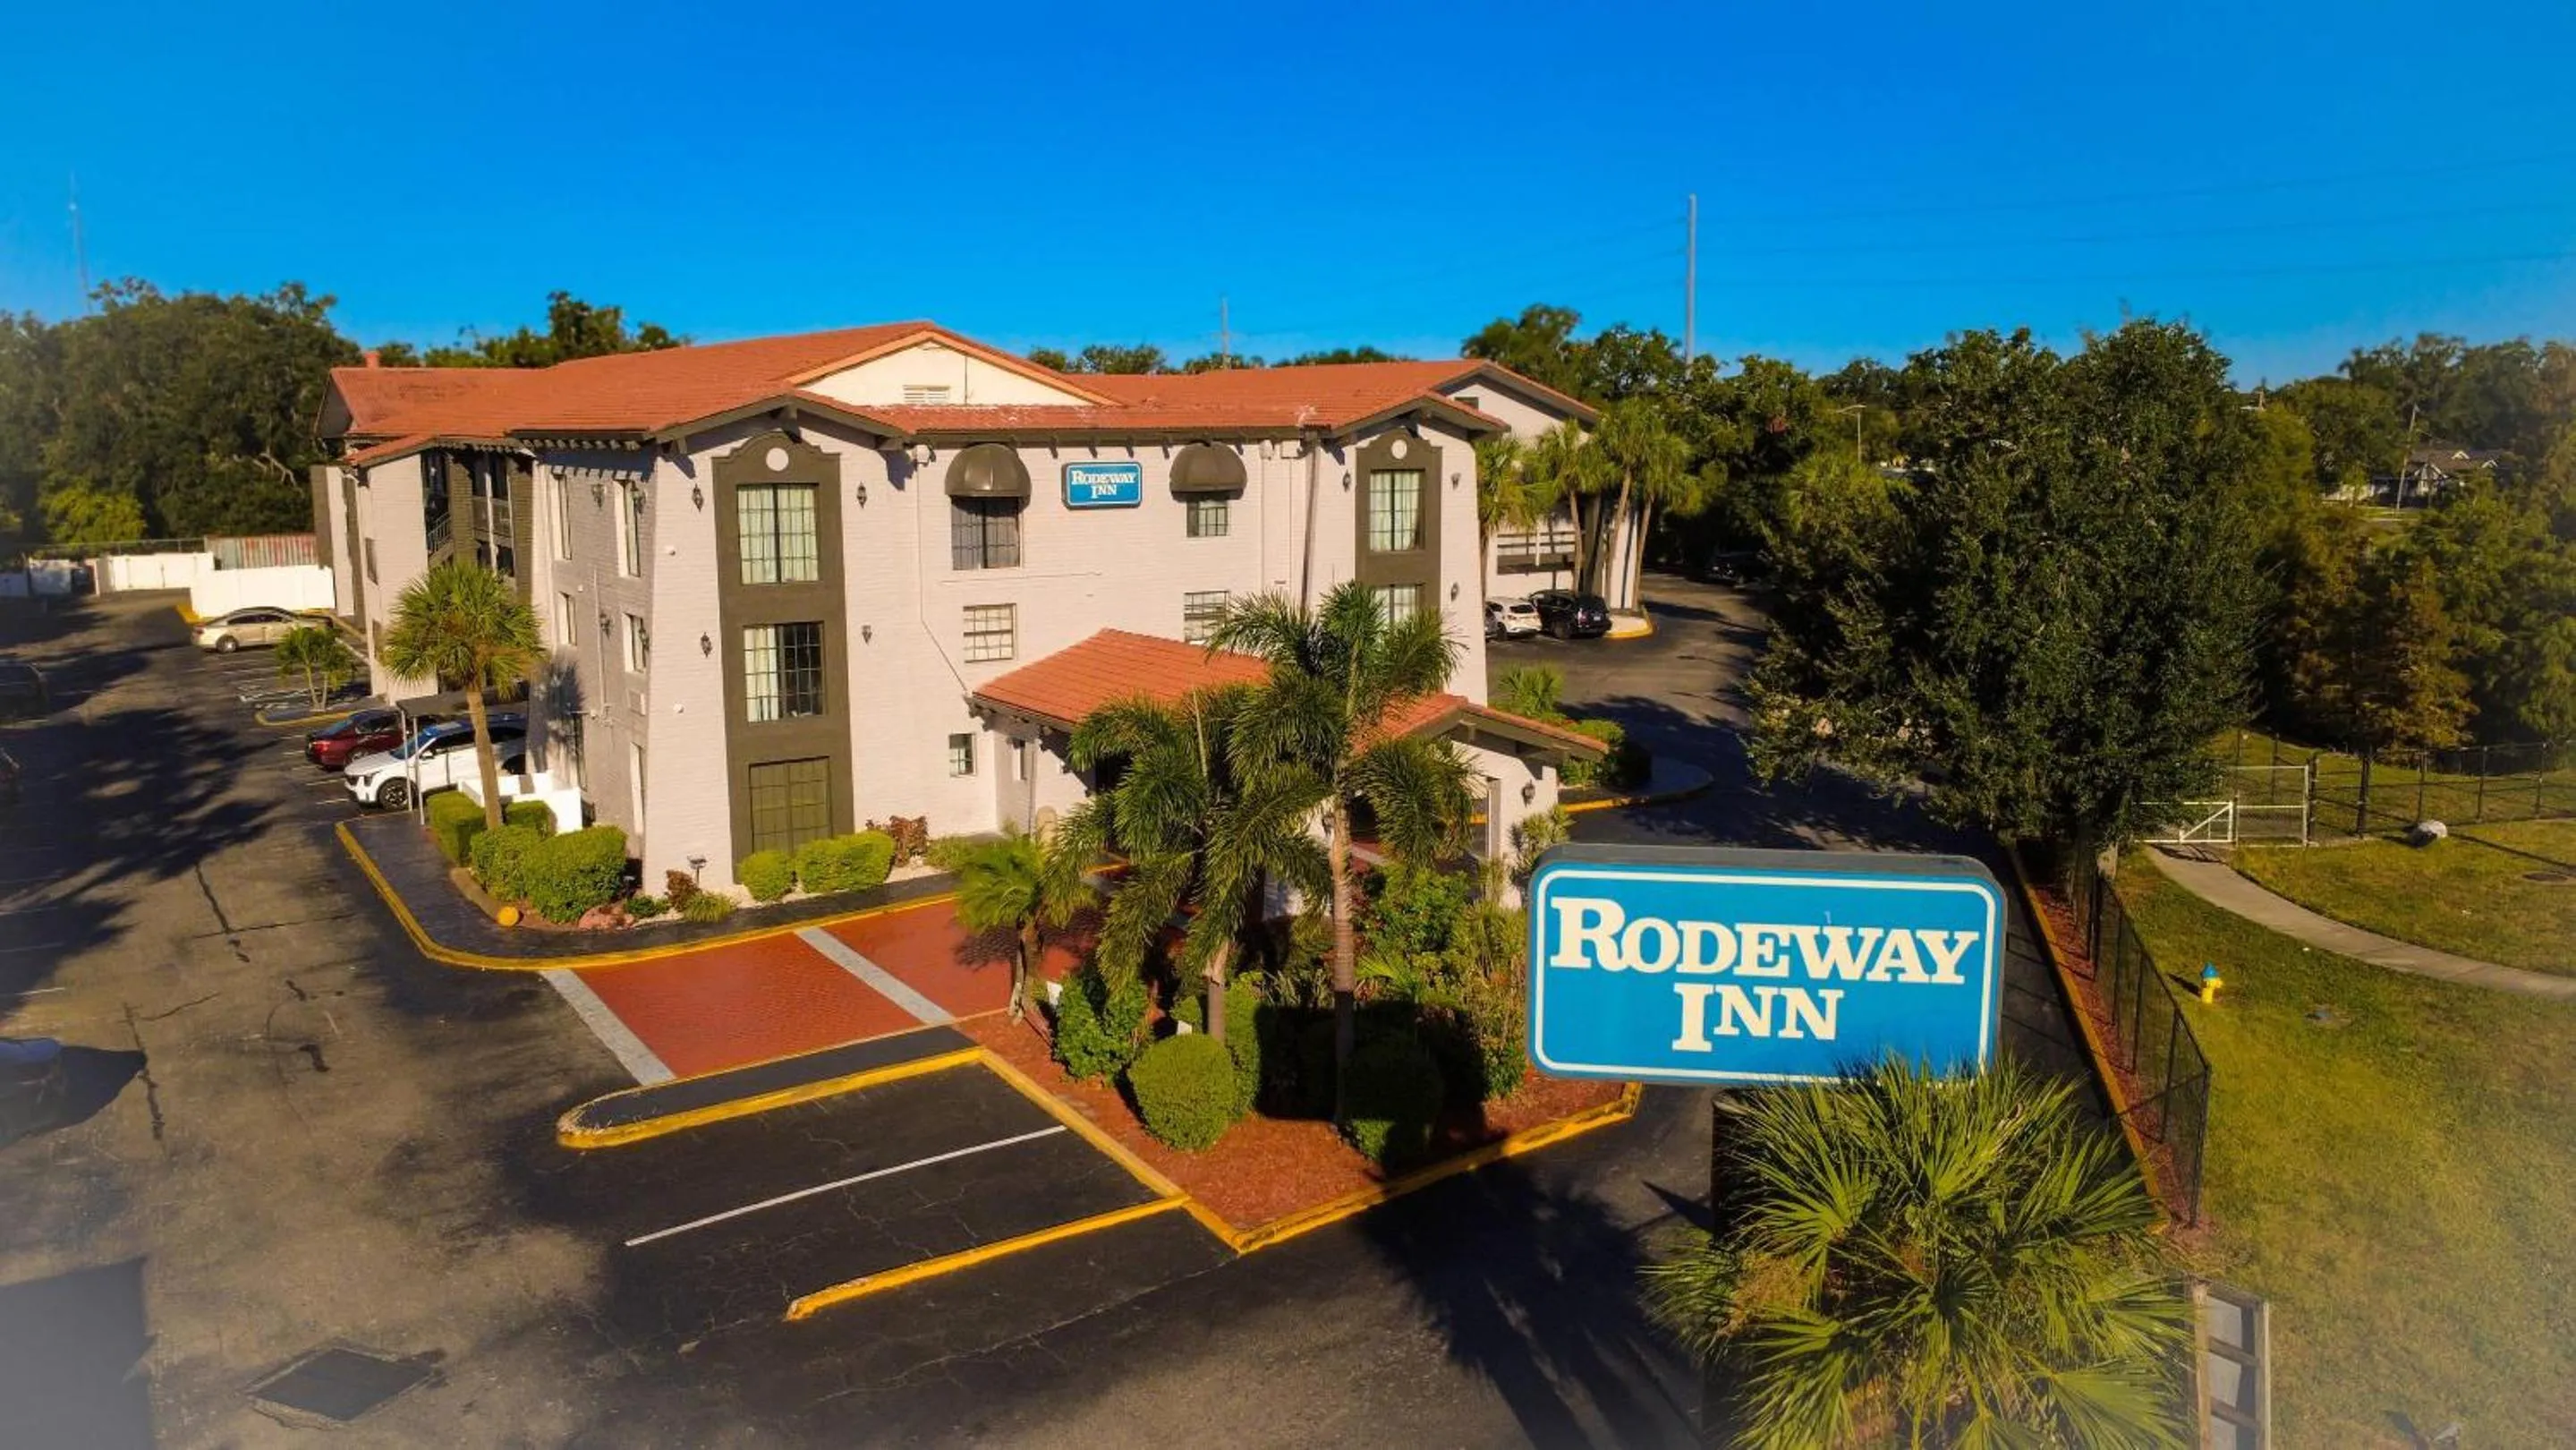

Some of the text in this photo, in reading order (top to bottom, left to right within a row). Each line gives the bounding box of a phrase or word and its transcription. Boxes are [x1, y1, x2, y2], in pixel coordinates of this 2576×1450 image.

[1071, 470, 1136, 485] RODEWAY
[1091, 484, 1118, 499] INN
[1549, 896, 1980, 985] RODEWAY
[1671, 983, 1846, 1053] INN
